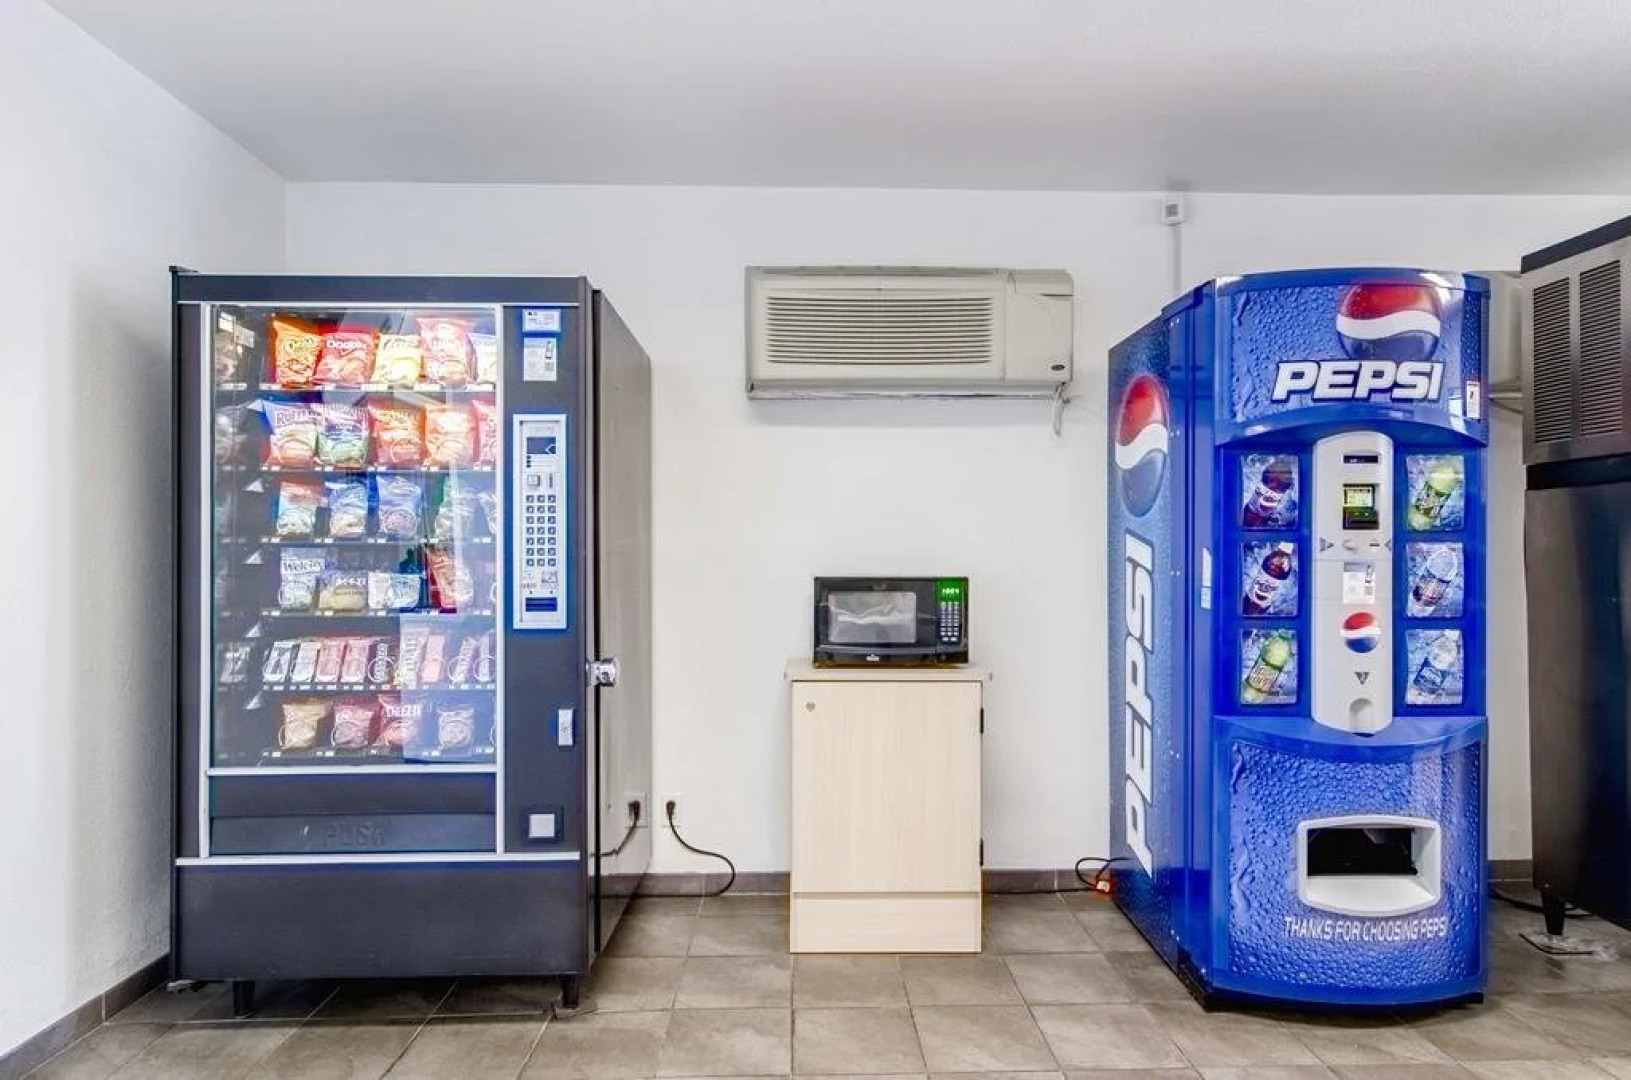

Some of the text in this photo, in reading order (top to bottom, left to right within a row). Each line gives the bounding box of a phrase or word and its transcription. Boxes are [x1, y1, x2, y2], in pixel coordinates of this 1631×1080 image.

[1271, 360, 1444, 402] PEPSI
[1125, 531, 1153, 880] PEPSI
[1284, 915, 1331, 939] THANKS
[1334, 919, 1360, 942] FOR
[1362, 917, 1418, 941] CHOOSING
